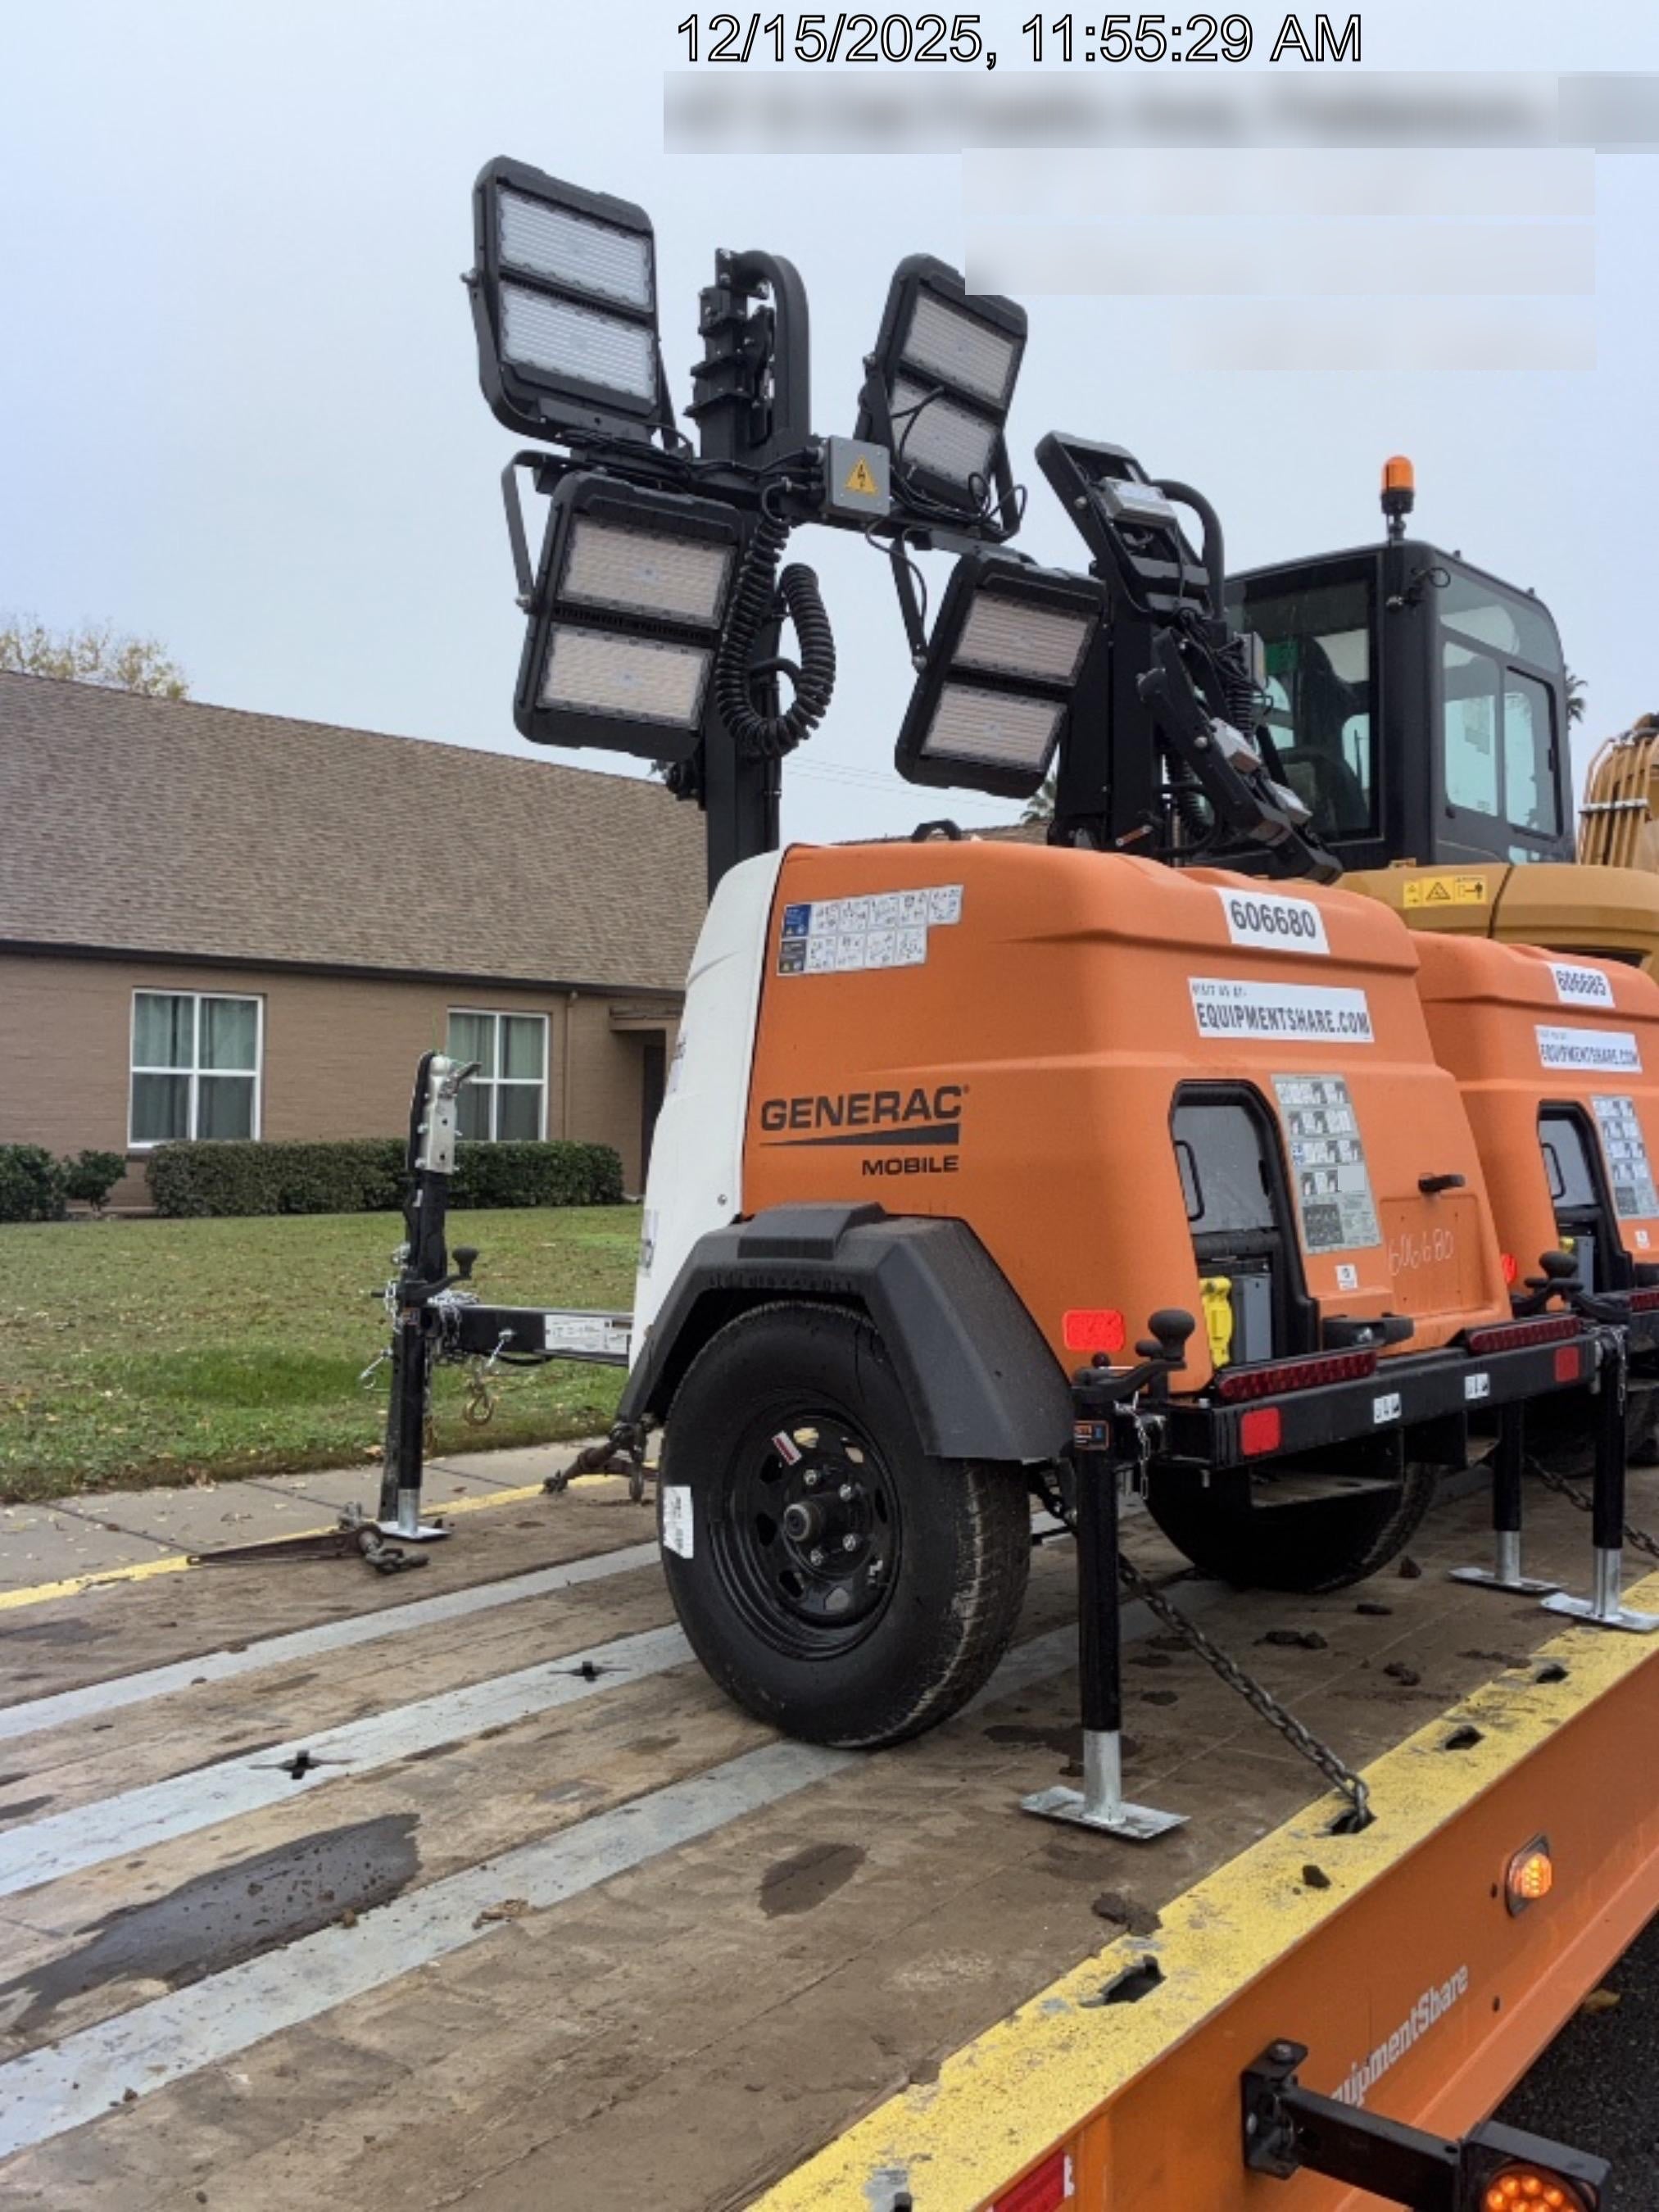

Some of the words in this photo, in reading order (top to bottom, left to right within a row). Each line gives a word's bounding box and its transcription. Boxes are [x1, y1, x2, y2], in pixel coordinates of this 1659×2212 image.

[1231, 900, 1317, 939] 606680
[1196, 1002, 1371, 1035] EQUIPMENTSHARE.COM
[761, 1085, 963, 1131] GENERAC
[861, 1154, 960, 1176] MOBILE
[1388, 1227, 1455, 1277] 606680
